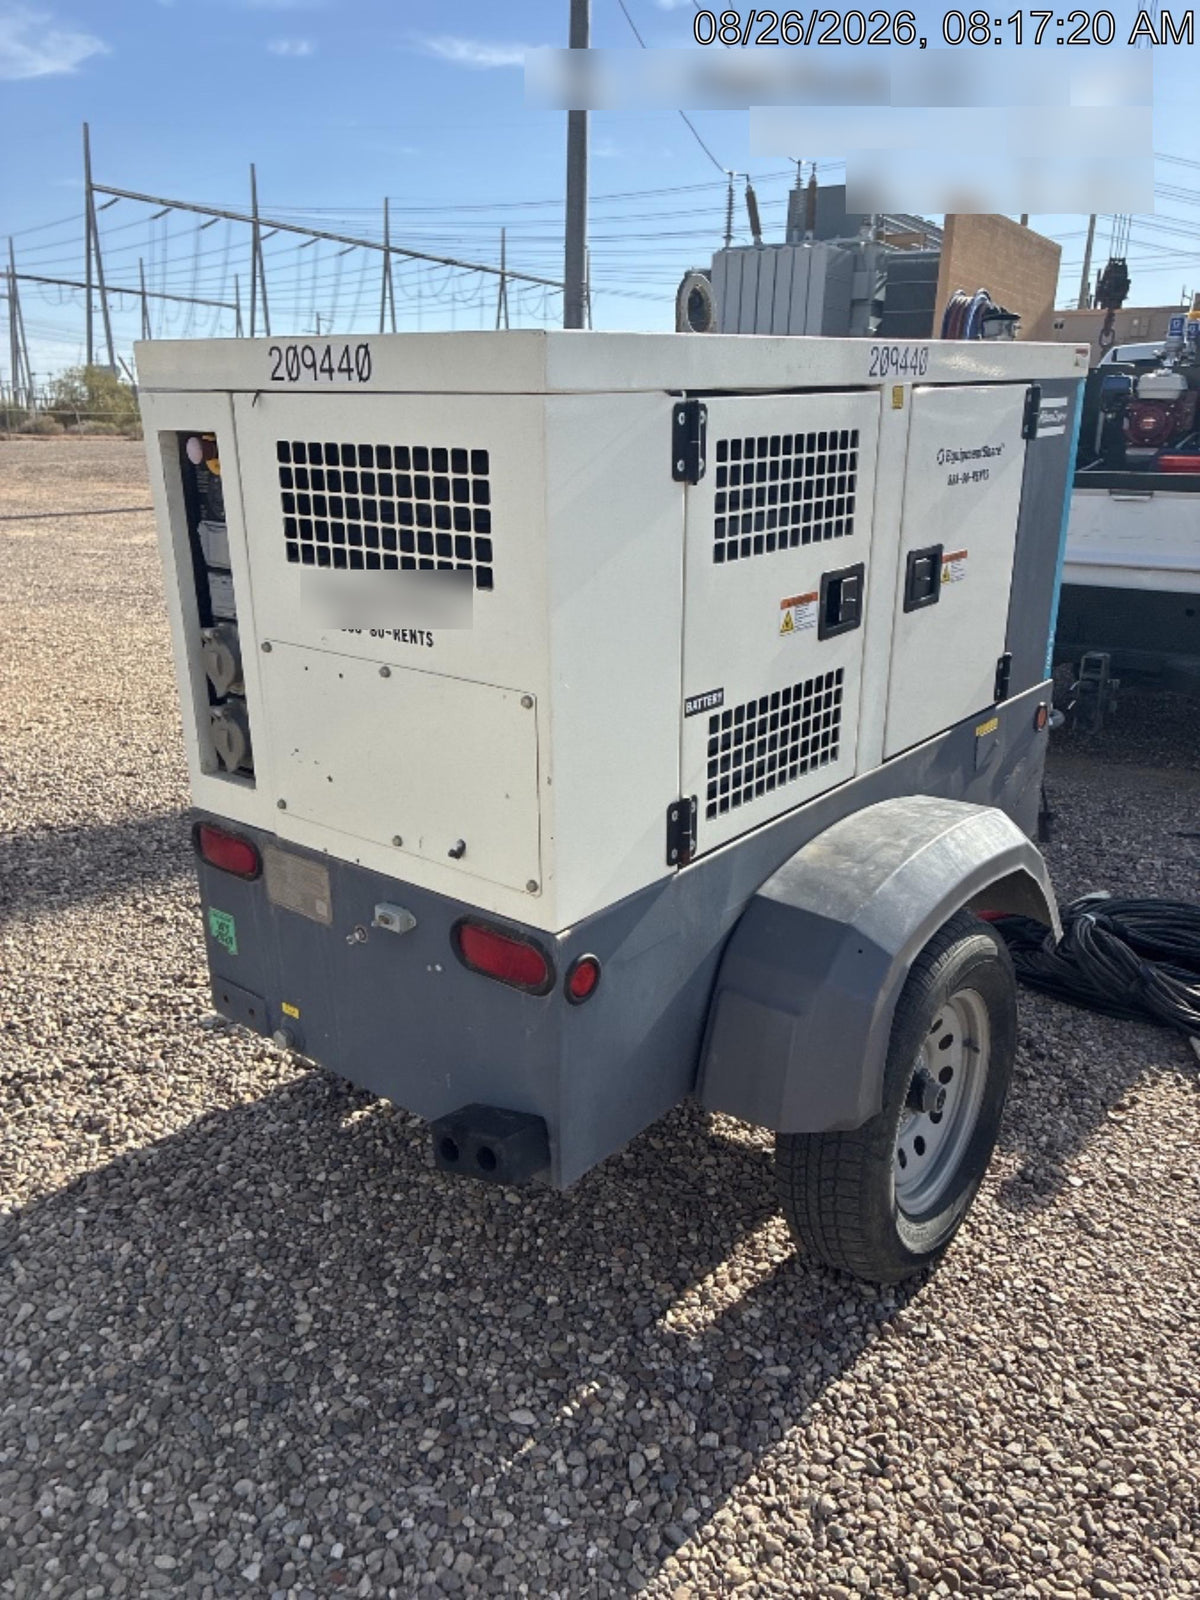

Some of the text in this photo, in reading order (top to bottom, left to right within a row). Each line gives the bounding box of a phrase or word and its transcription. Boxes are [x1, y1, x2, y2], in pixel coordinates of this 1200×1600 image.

[268, 343, 372, 382] 209440
[869, 346, 929, 377] 209440
[686, 691, 723, 714] BATTERY
